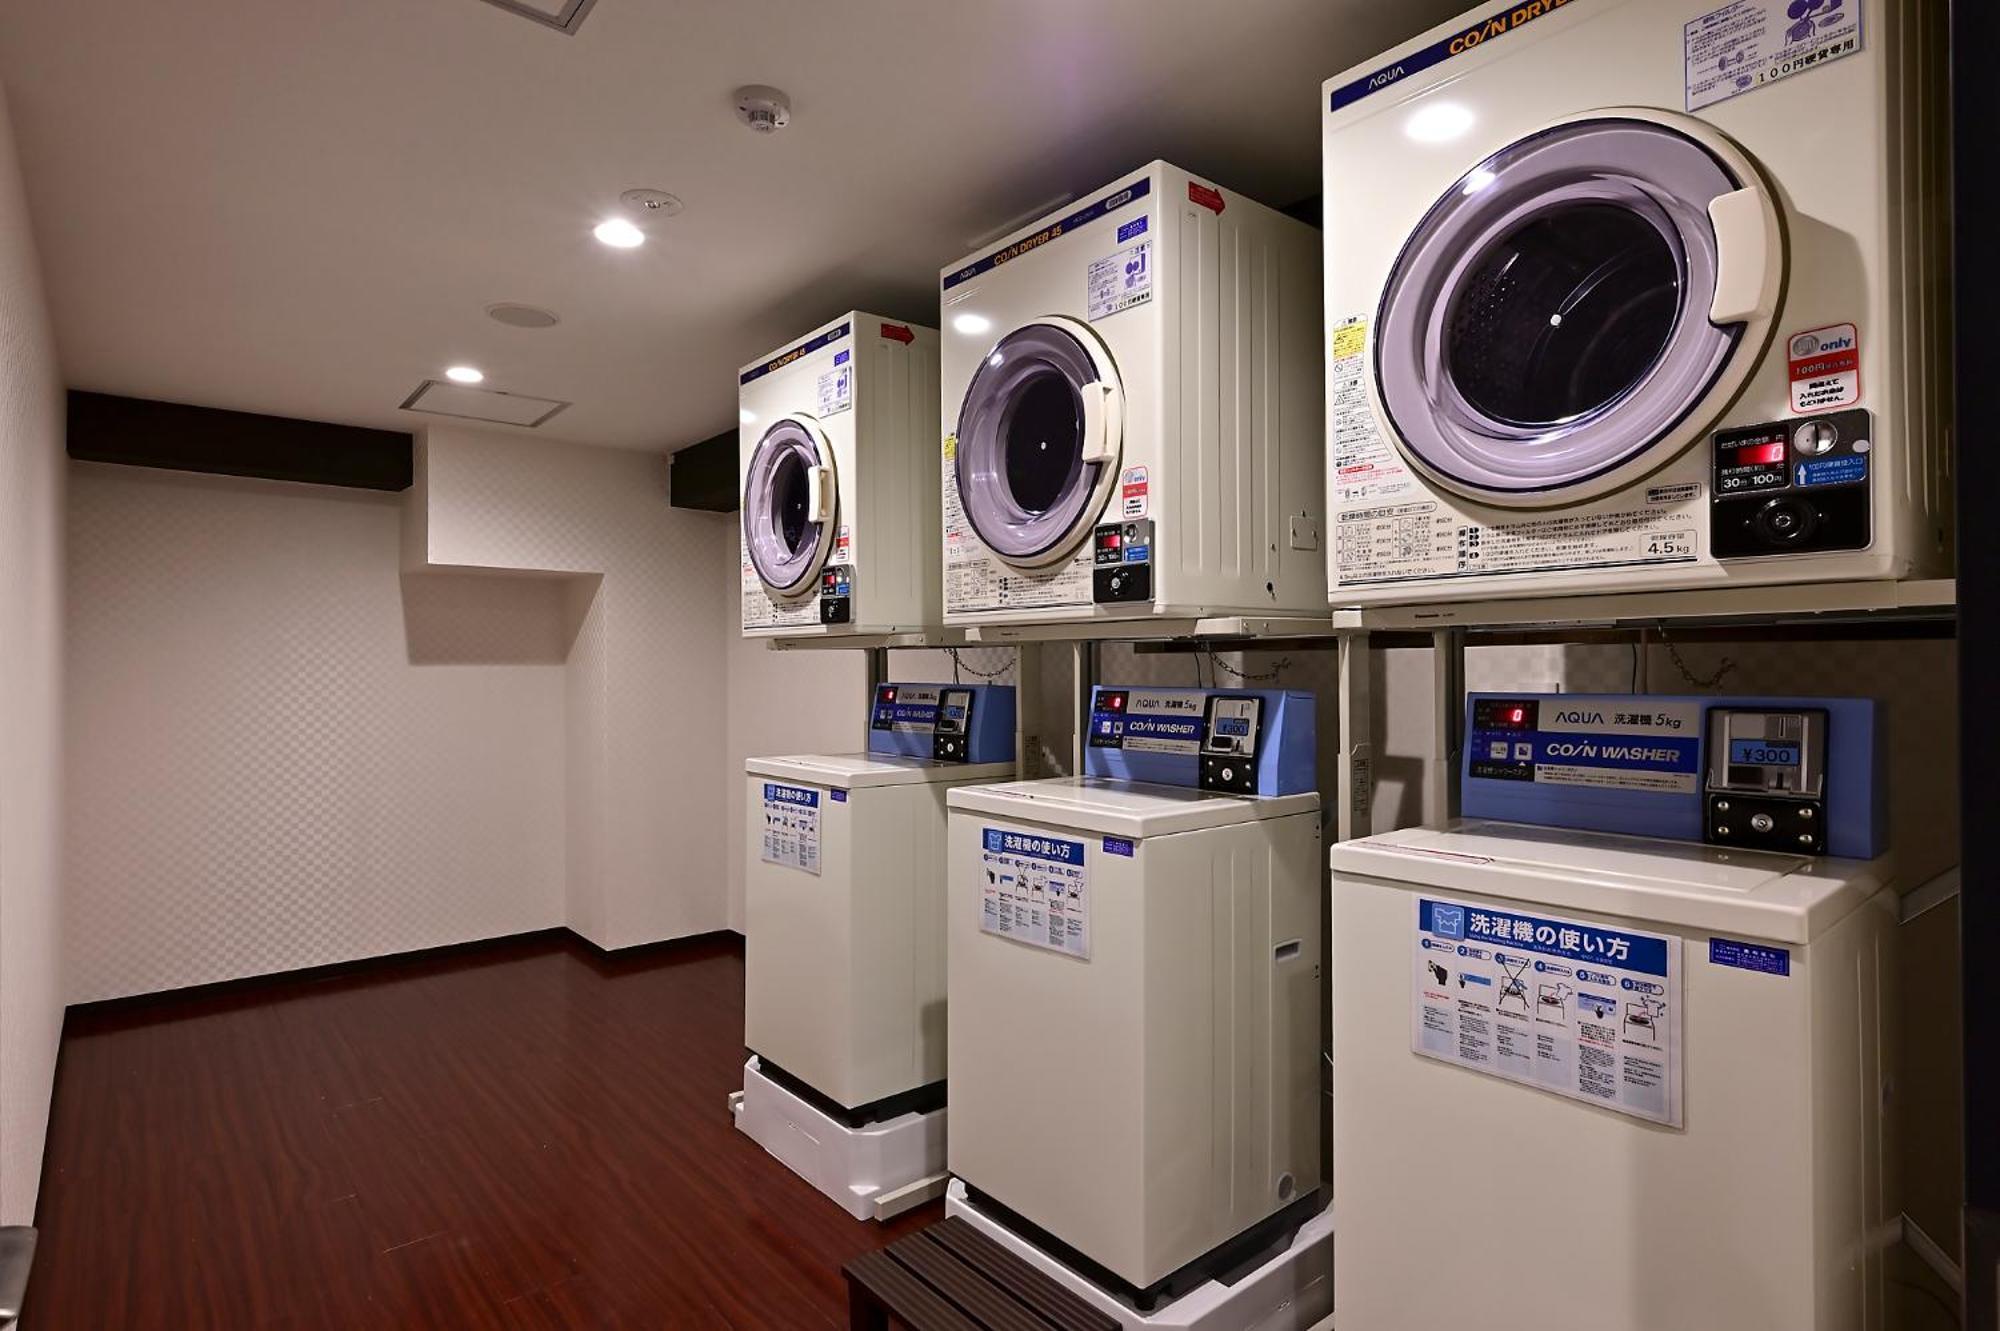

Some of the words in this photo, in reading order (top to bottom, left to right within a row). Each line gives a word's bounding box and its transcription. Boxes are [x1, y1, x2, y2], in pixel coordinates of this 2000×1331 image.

[1368, 66, 1405, 90] AQUA
[1820, 337, 1852, 351] only
[1771, 442, 1784, 461] 0
[1647, 541, 1674, 554] 4.5
[1676, 545, 1690, 554] kg
[1135, 699, 1160, 709] AQUA
[1512, 708, 1523, 722] 0
[1555, 711, 1604, 724] AQUA
[1614, 713, 1652, 726] 洗濯機
[1655, 713, 1682, 729] 5kg
[1130, 718, 1156, 732] COIN
[1156, 722, 1196, 733] WASHER
[1546, 740, 1596, 758] COIN
[1602, 746, 1681, 762] WASHER
[1743, 748, 1791, 763] ¥300
[1004, 834, 1071, 859] 洗濯機の使い方
[1470, 912, 1631, 960] 洗濯機の使い方
